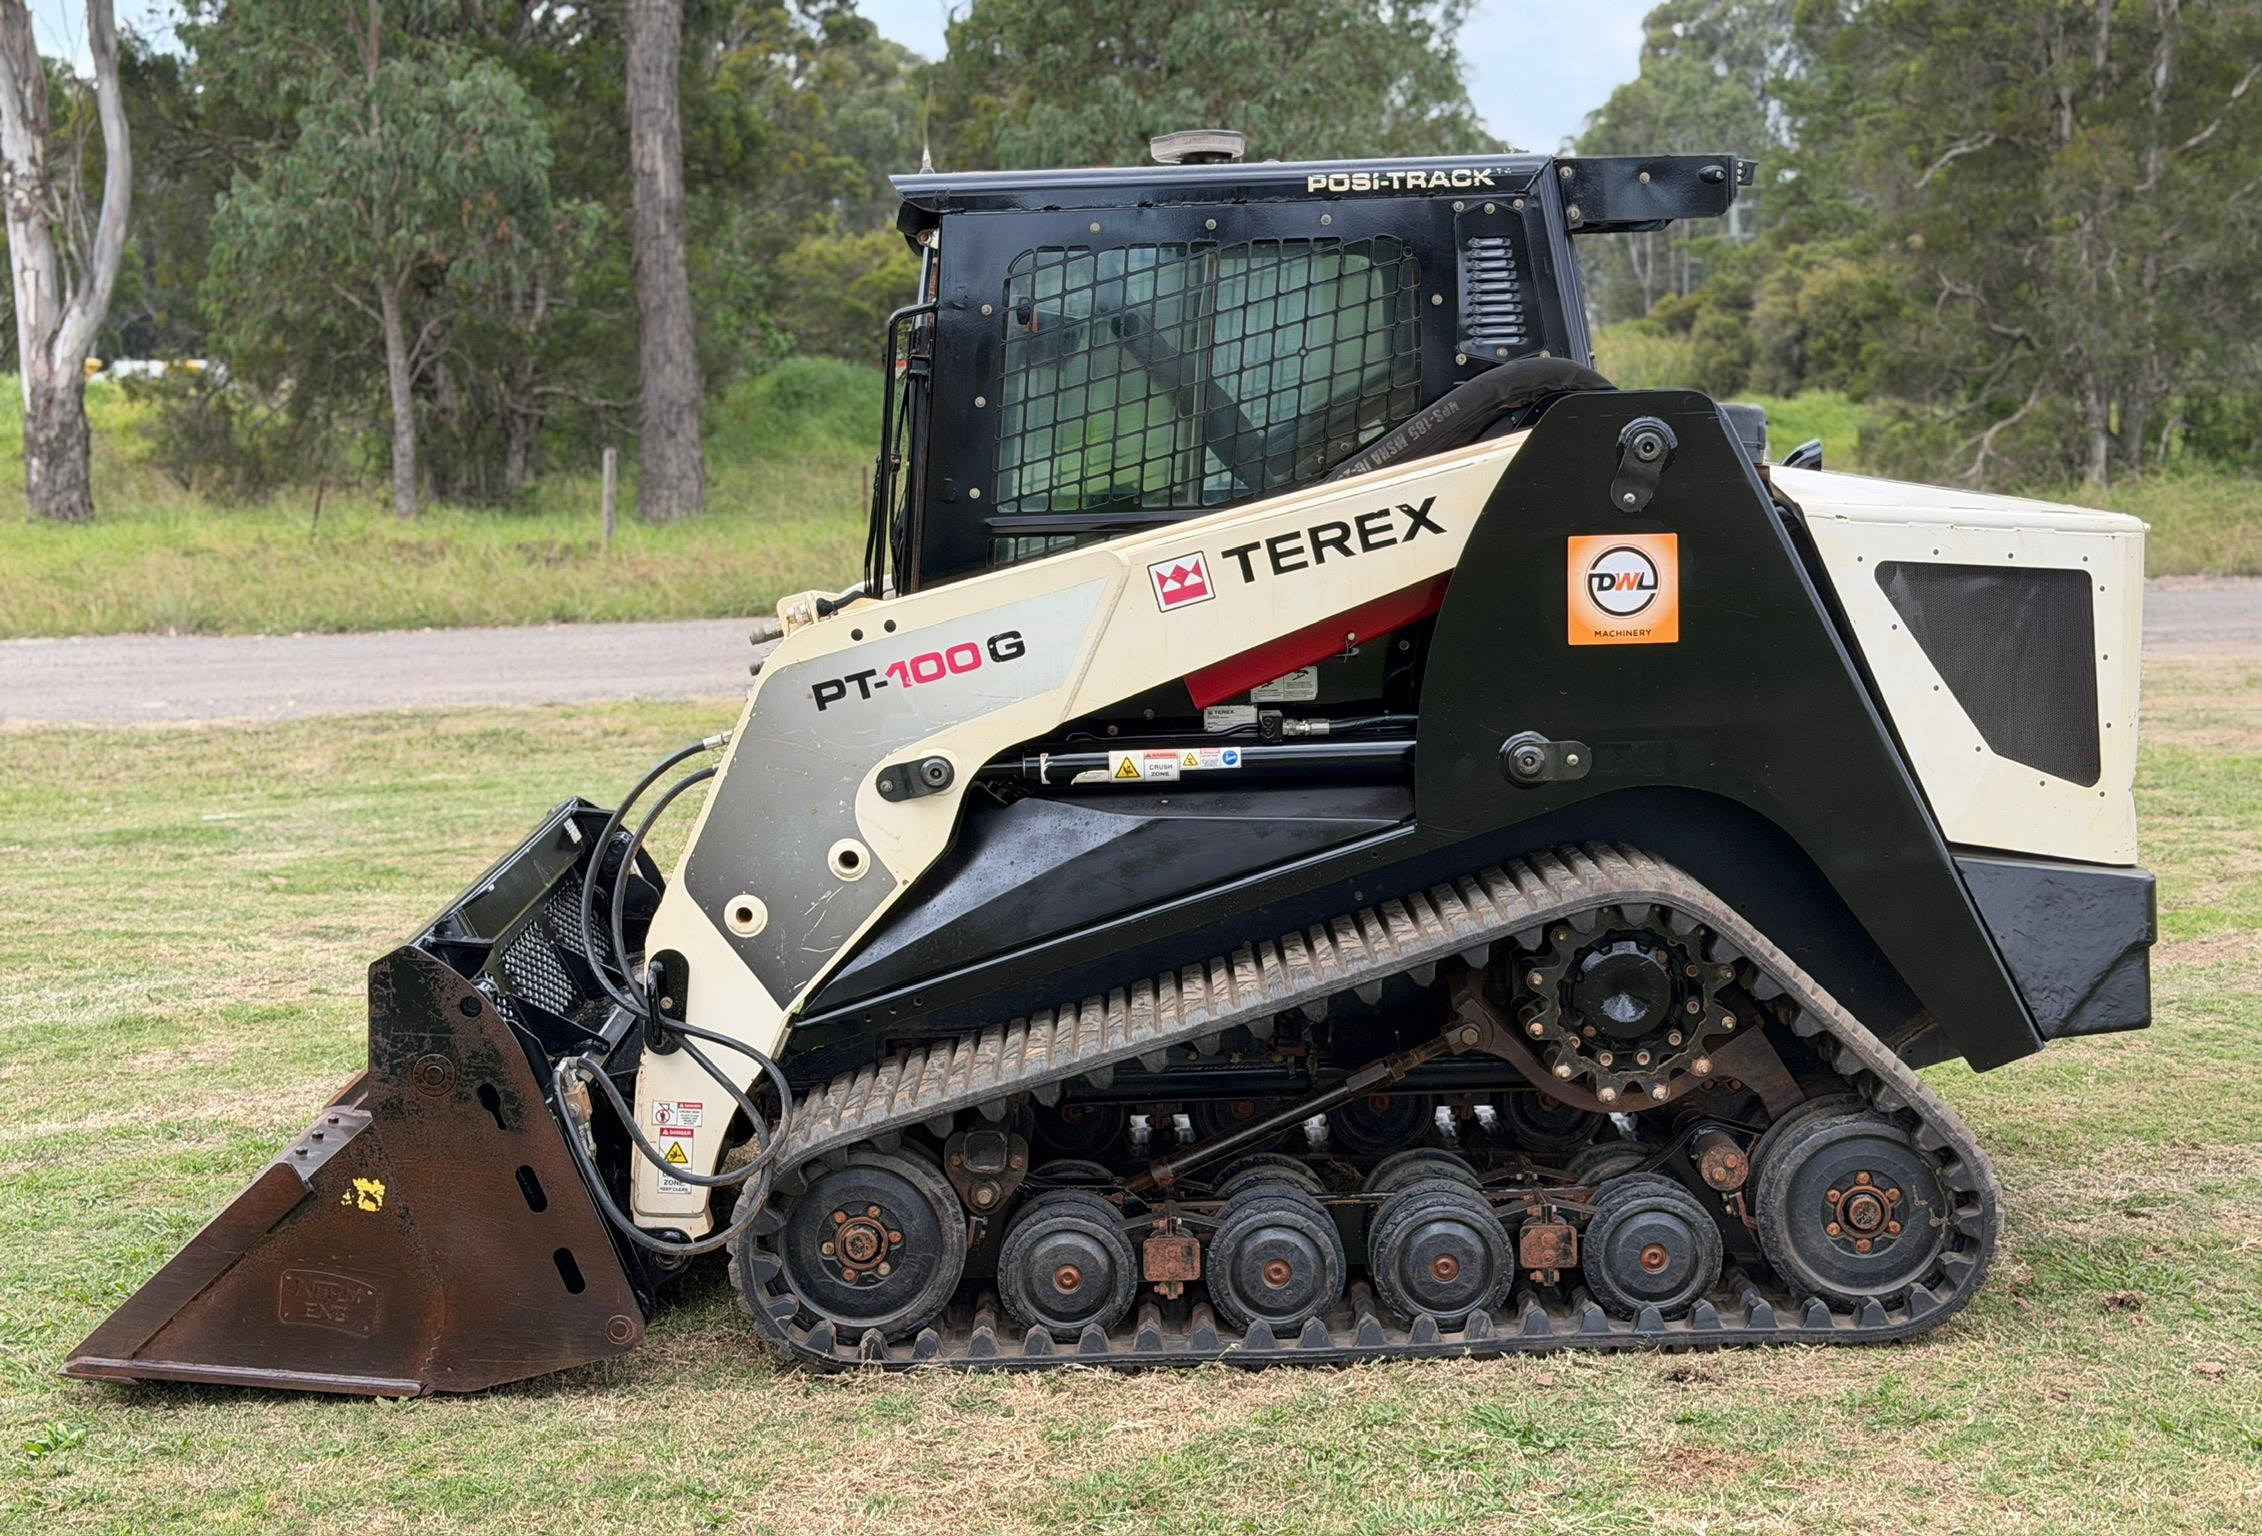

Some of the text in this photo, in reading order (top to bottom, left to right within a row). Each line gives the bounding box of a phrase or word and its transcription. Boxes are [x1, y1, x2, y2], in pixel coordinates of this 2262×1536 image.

[1307, 169, 1495, 193] POSI-TRACK
[1221, 495, 1448, 584] TEREX
[1588, 571, 1658, 592] DWL
[1594, 629, 1652, 638] MACHINERY
[1149, 763, 1174, 771] CRUSH
